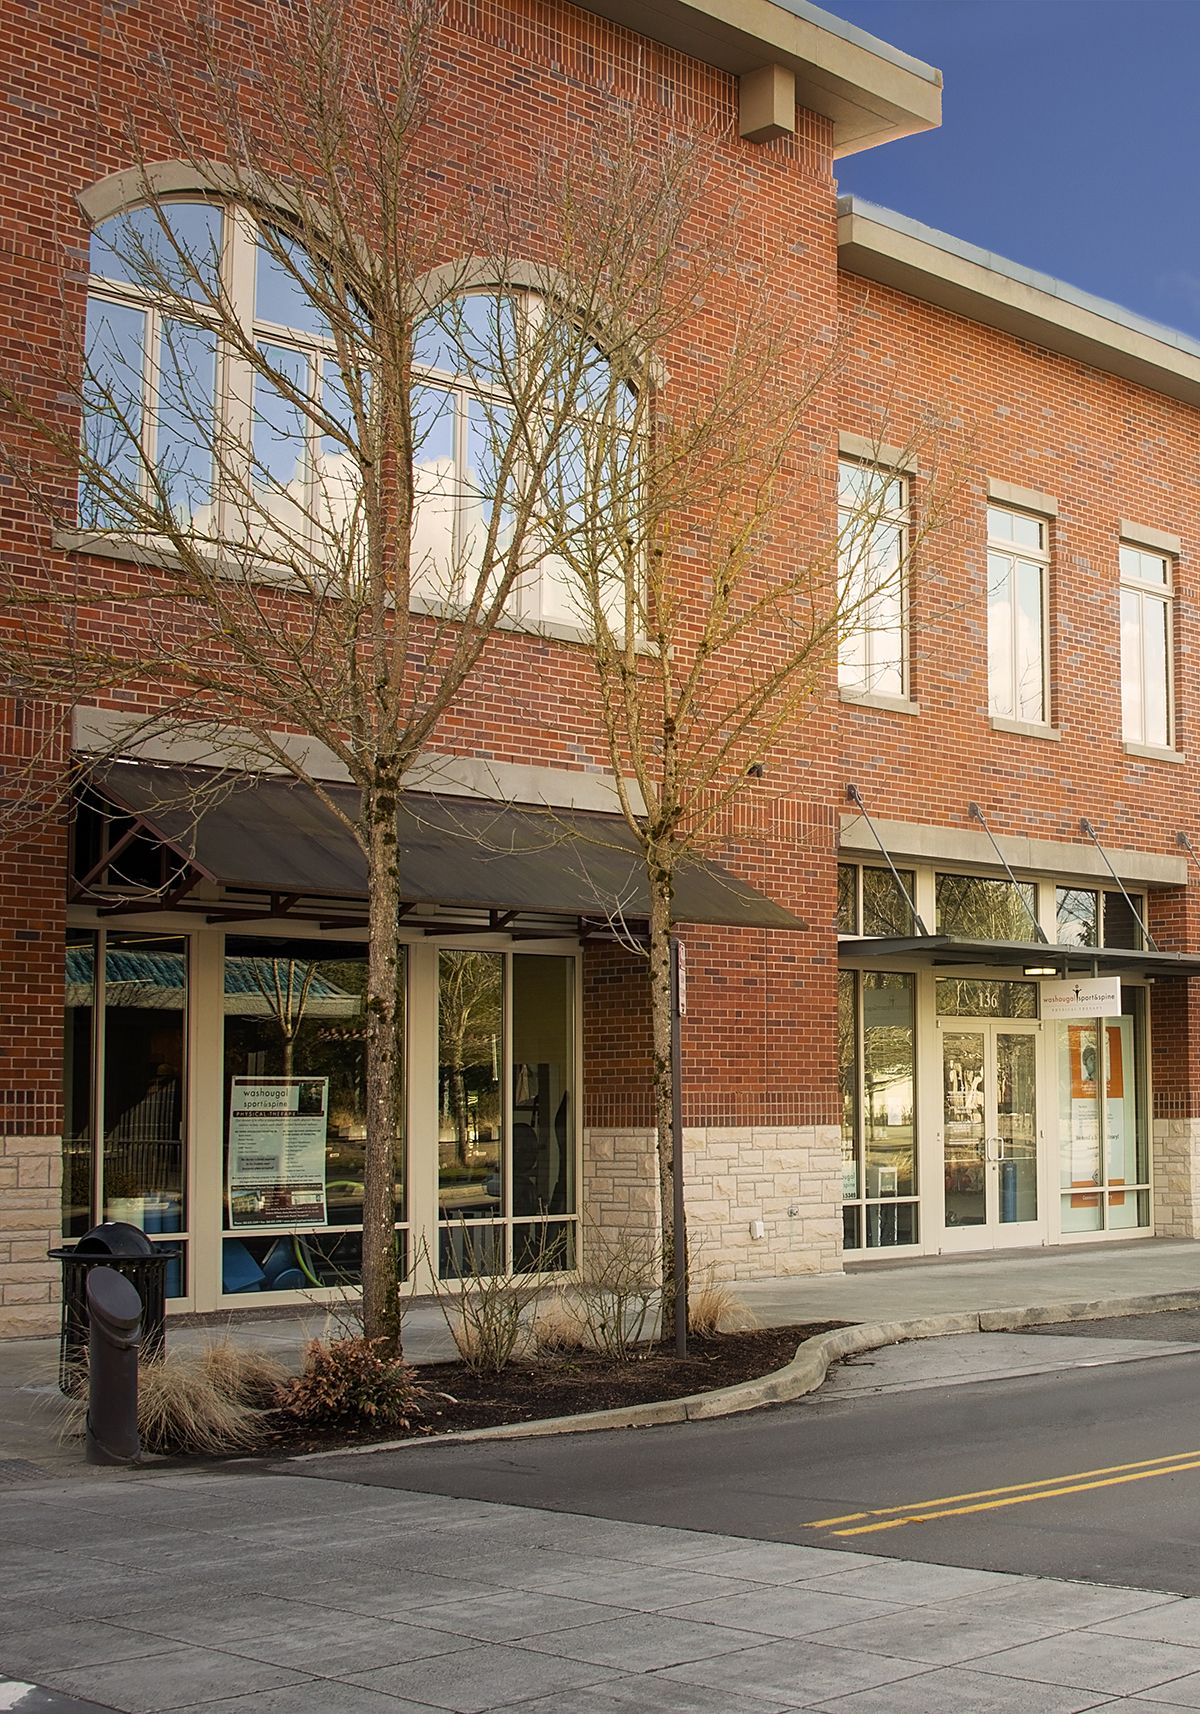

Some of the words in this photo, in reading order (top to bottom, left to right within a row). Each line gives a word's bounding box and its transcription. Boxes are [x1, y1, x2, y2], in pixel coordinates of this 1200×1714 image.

[979, 992, 997, 1008] 136
[1043, 994, 1075, 1003] washougal
[1078, 993, 1115, 1002] sport&spine
[243, 1088, 289, 1099] washougal
[243, 1100, 288, 1109] sport&spine
